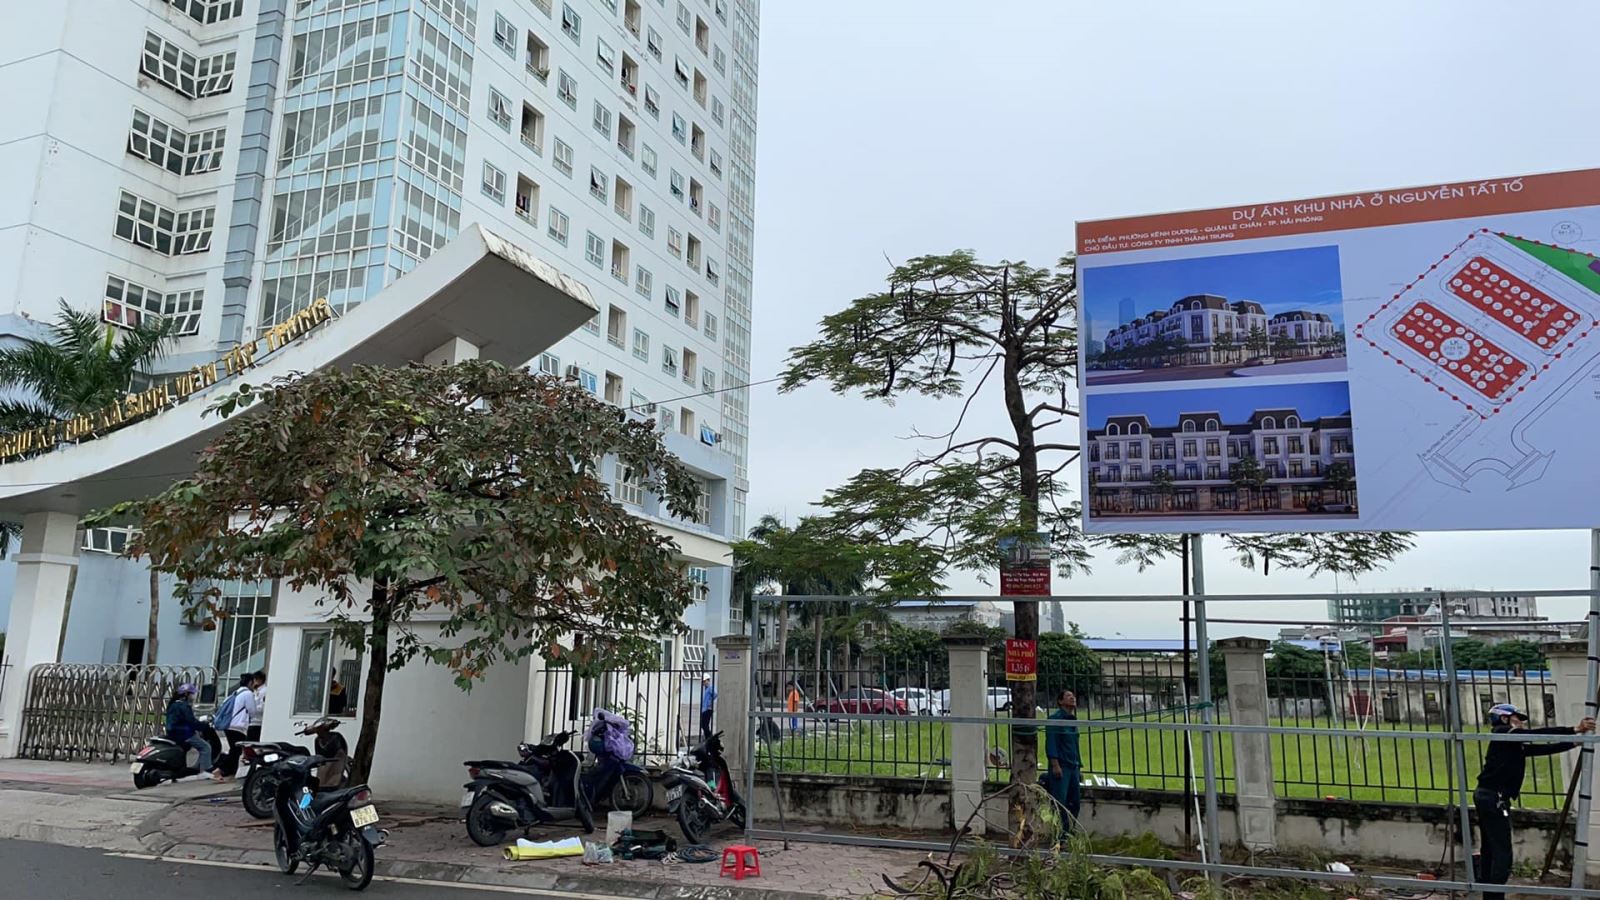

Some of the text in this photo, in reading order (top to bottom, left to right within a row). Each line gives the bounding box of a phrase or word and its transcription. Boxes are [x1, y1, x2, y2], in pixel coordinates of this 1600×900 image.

[1232, 177, 1524, 221] DỰ ÁN: KHU NHÀ Ở NGUYỄN TẤT TỐ
[125, 383, 170, 419] SINH
[176, 361, 218, 397] VIÊN
[221, 341, 259, 376] TẬP
[264, 297, 332, 352] TRUNG
